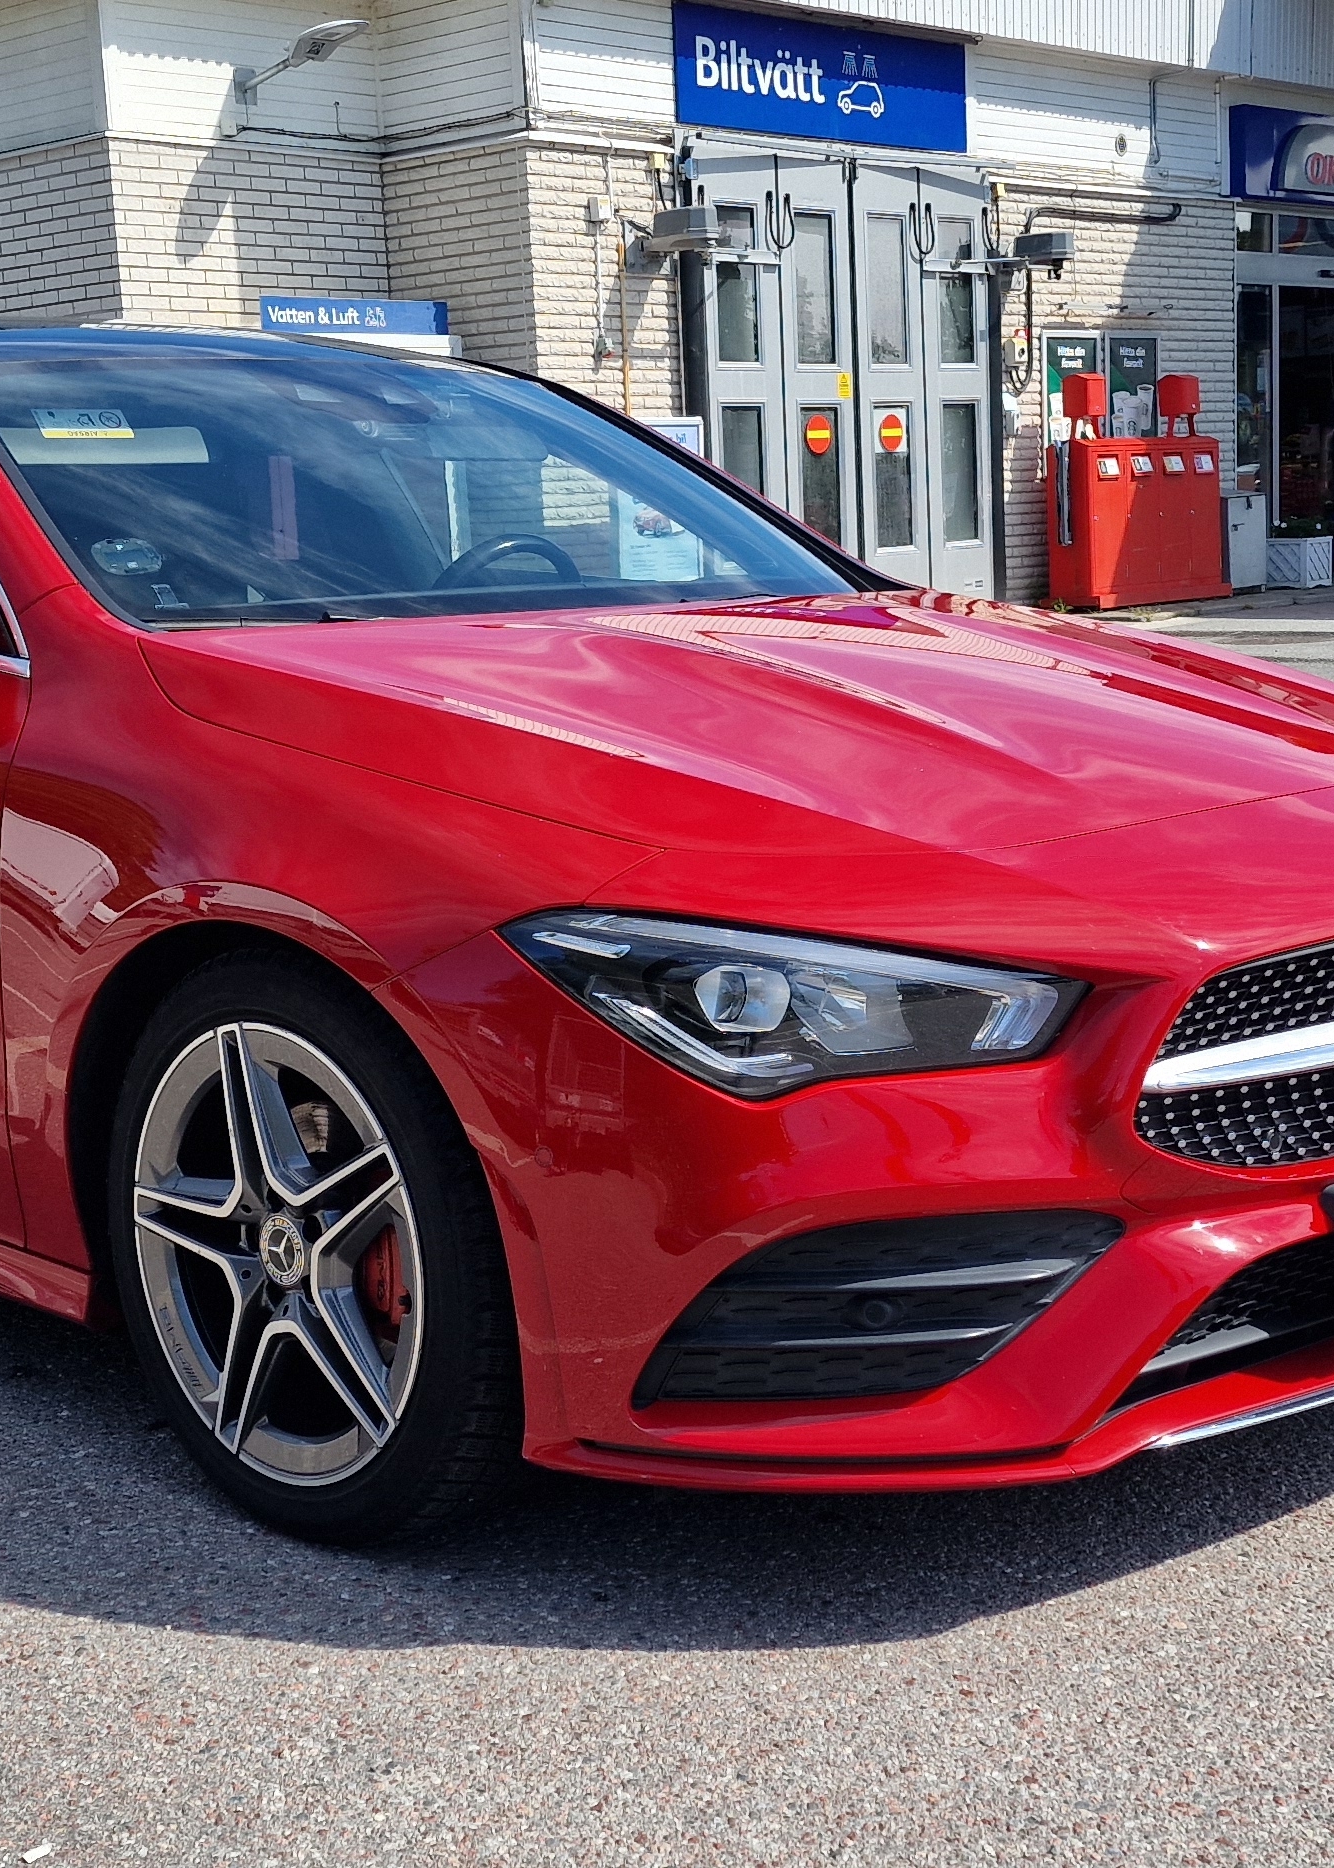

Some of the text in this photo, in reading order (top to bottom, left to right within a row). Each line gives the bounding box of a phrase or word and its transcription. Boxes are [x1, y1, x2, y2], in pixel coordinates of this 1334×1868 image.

[694, 34, 826, 104] Biltvätt
[267, 305, 361, 325] Vatten & Luft
